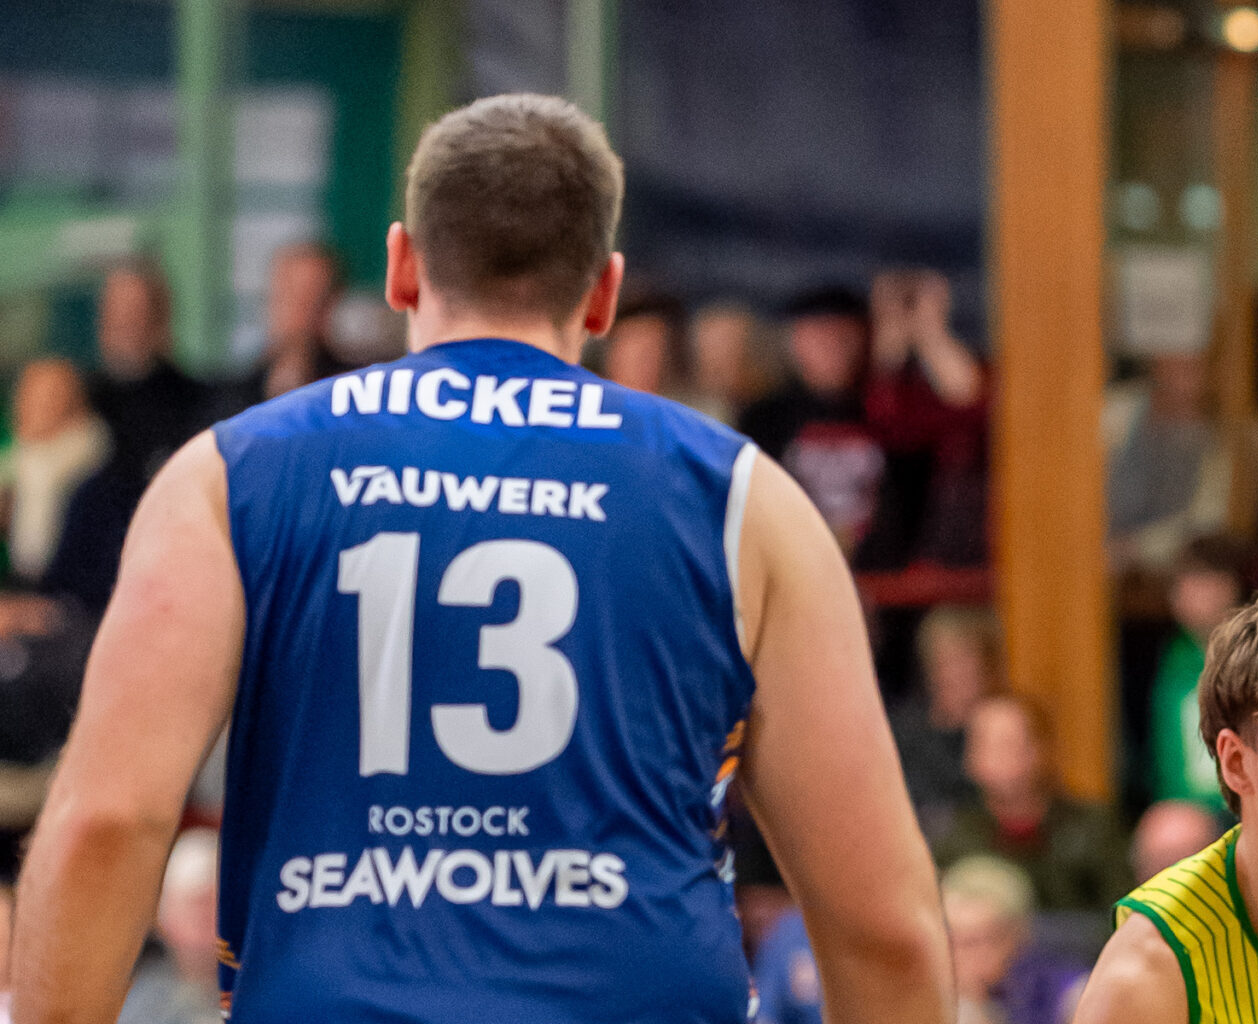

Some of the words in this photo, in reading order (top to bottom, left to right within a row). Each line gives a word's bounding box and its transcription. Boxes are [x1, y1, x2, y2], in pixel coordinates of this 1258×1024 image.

[332, 367, 622, 428] NICKEL
[331, 465, 608, 521] VAUWERK
[338, 531, 579, 778] 13
[368, 806, 530, 836] ROSTOCK
[277, 846, 629, 913] SEAWOLVES
